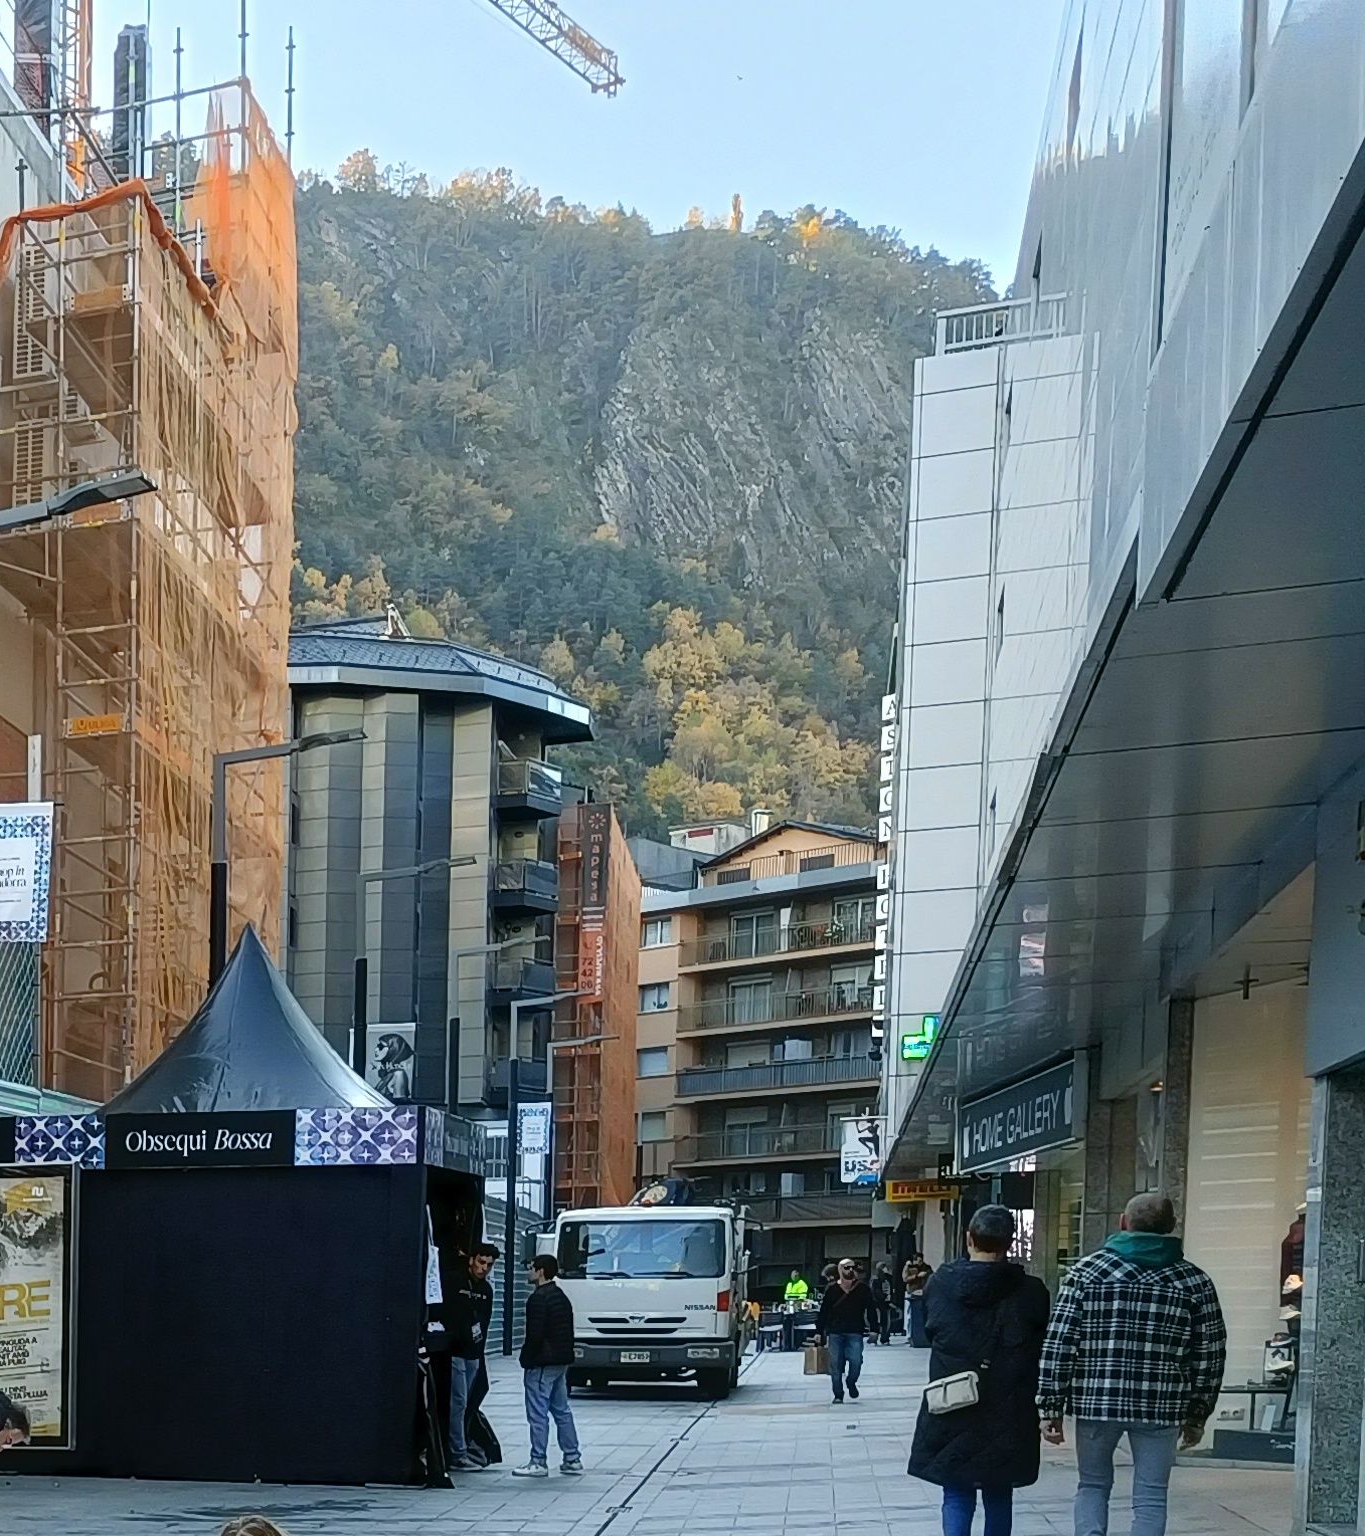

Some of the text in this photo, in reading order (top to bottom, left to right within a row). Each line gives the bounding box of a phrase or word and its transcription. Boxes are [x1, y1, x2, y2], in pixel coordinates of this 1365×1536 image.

[590, 833, 603, 902] mapesa
[125, 1128, 273, 1157] Obsequi Bossa
[973, 1089, 1061, 1155] HOME GALLERY
